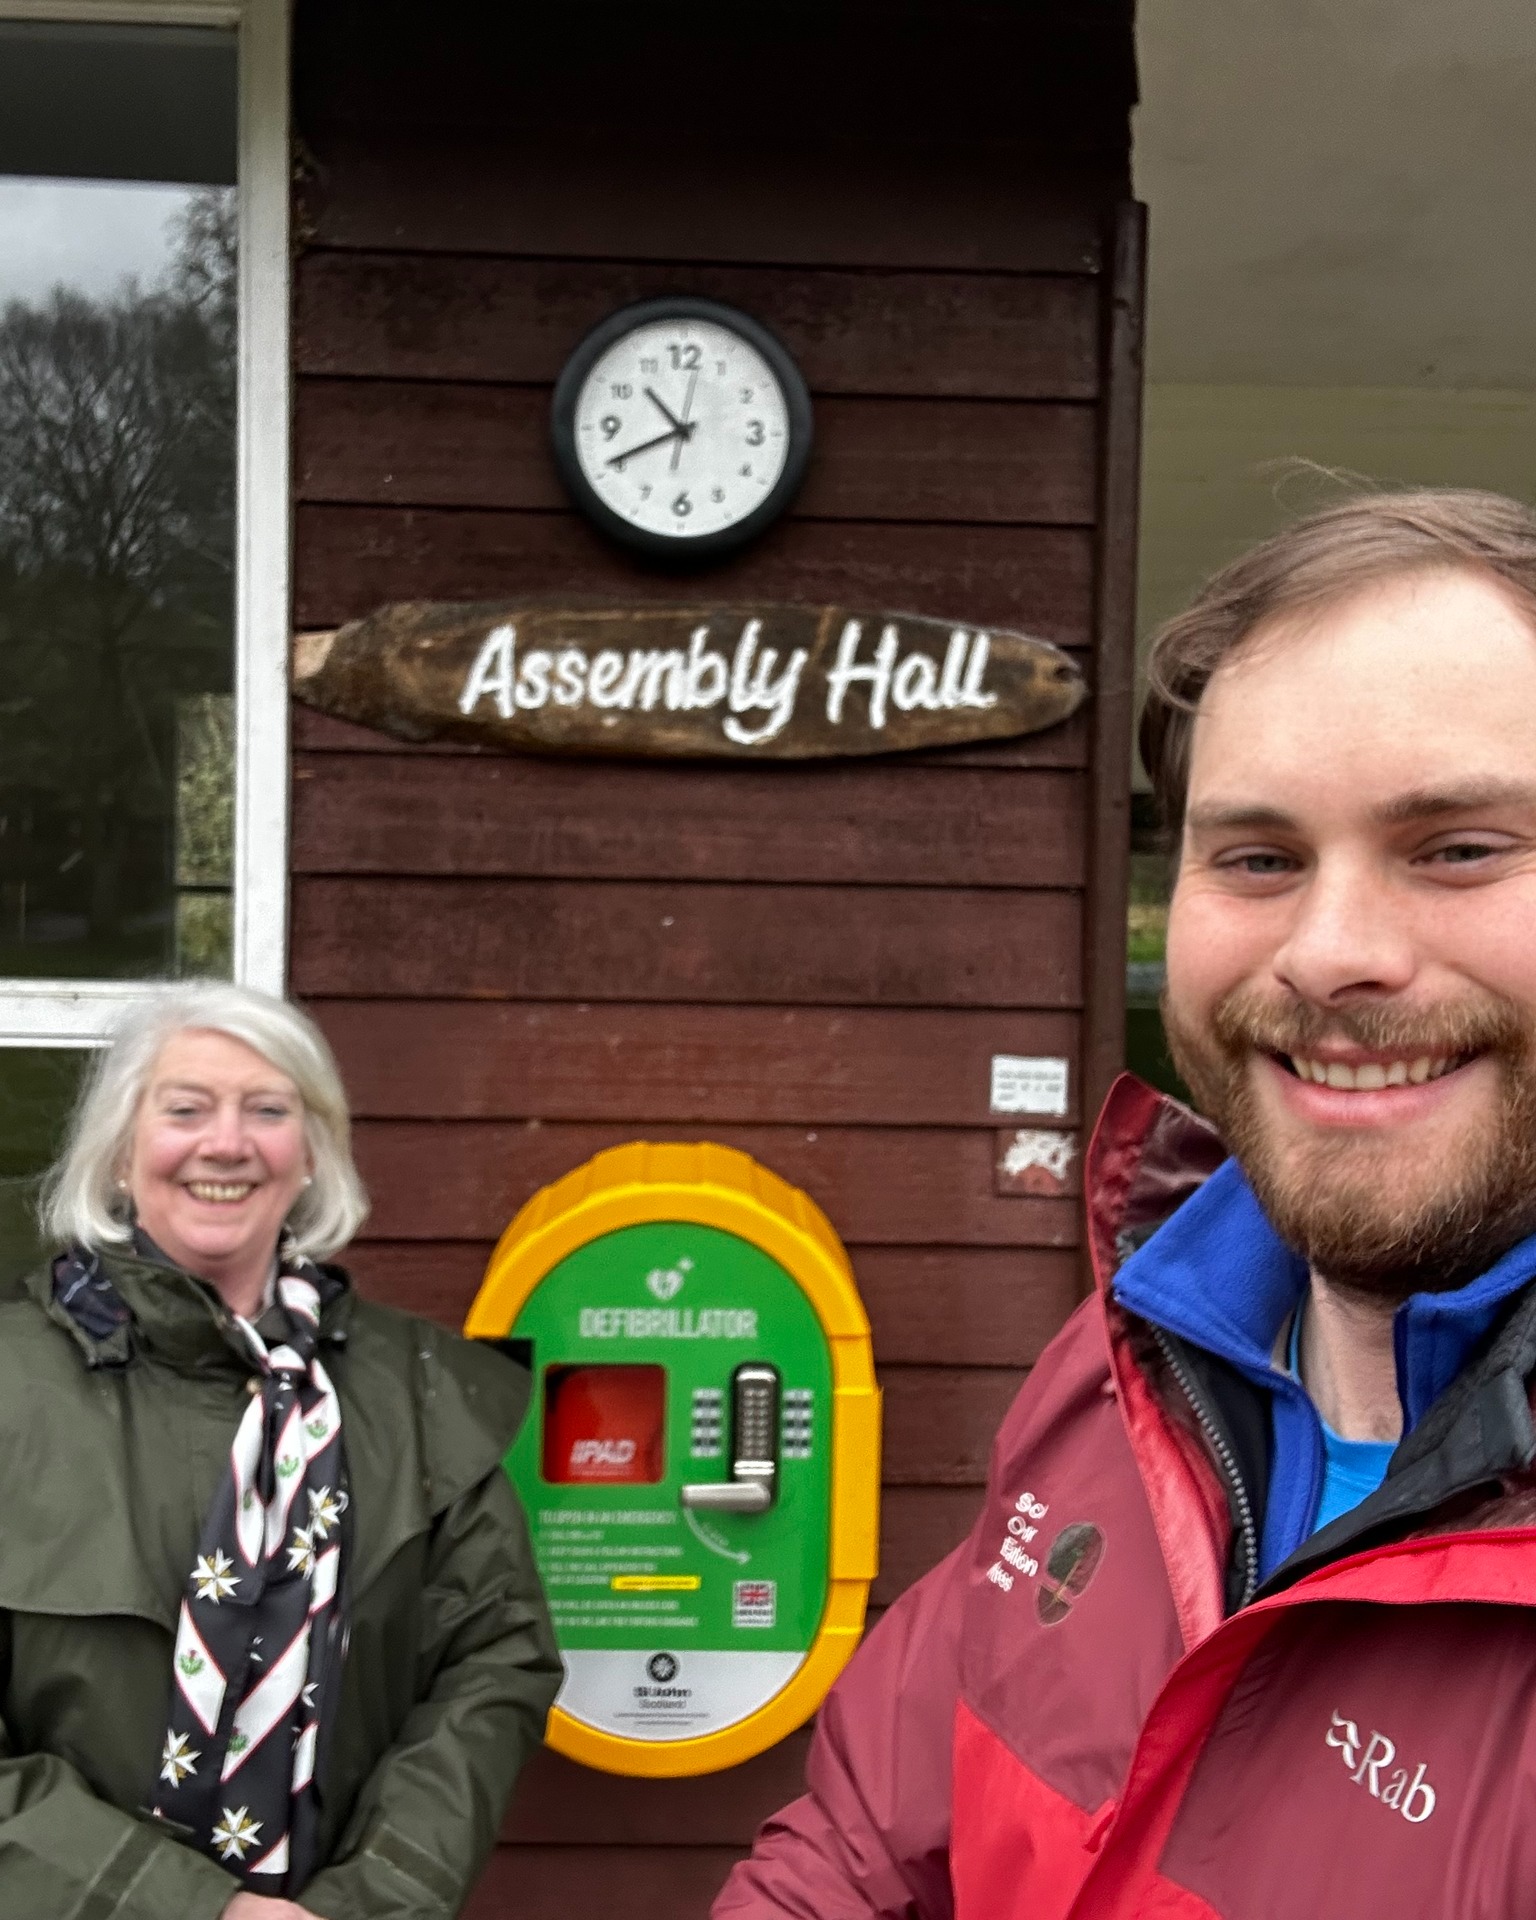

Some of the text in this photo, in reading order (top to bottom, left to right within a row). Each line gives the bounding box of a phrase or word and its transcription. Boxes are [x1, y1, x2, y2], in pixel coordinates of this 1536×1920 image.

[640, 357, 659, 374] 11
[667, 345, 701, 371] 12
[716, 360, 727, 376] 1
[611, 383, 633, 400] 10
[602, 415, 621, 441] 9
[746, 420, 765, 446] 3
[640, 484, 653, 500] 7
[671, 491, 692, 517] 6
[459, 619, 997, 746] Assembly Hall
[579, 1307, 757, 1338] DEFIBRILLATOR
[1350, 1730, 1436, 1823] Rab
